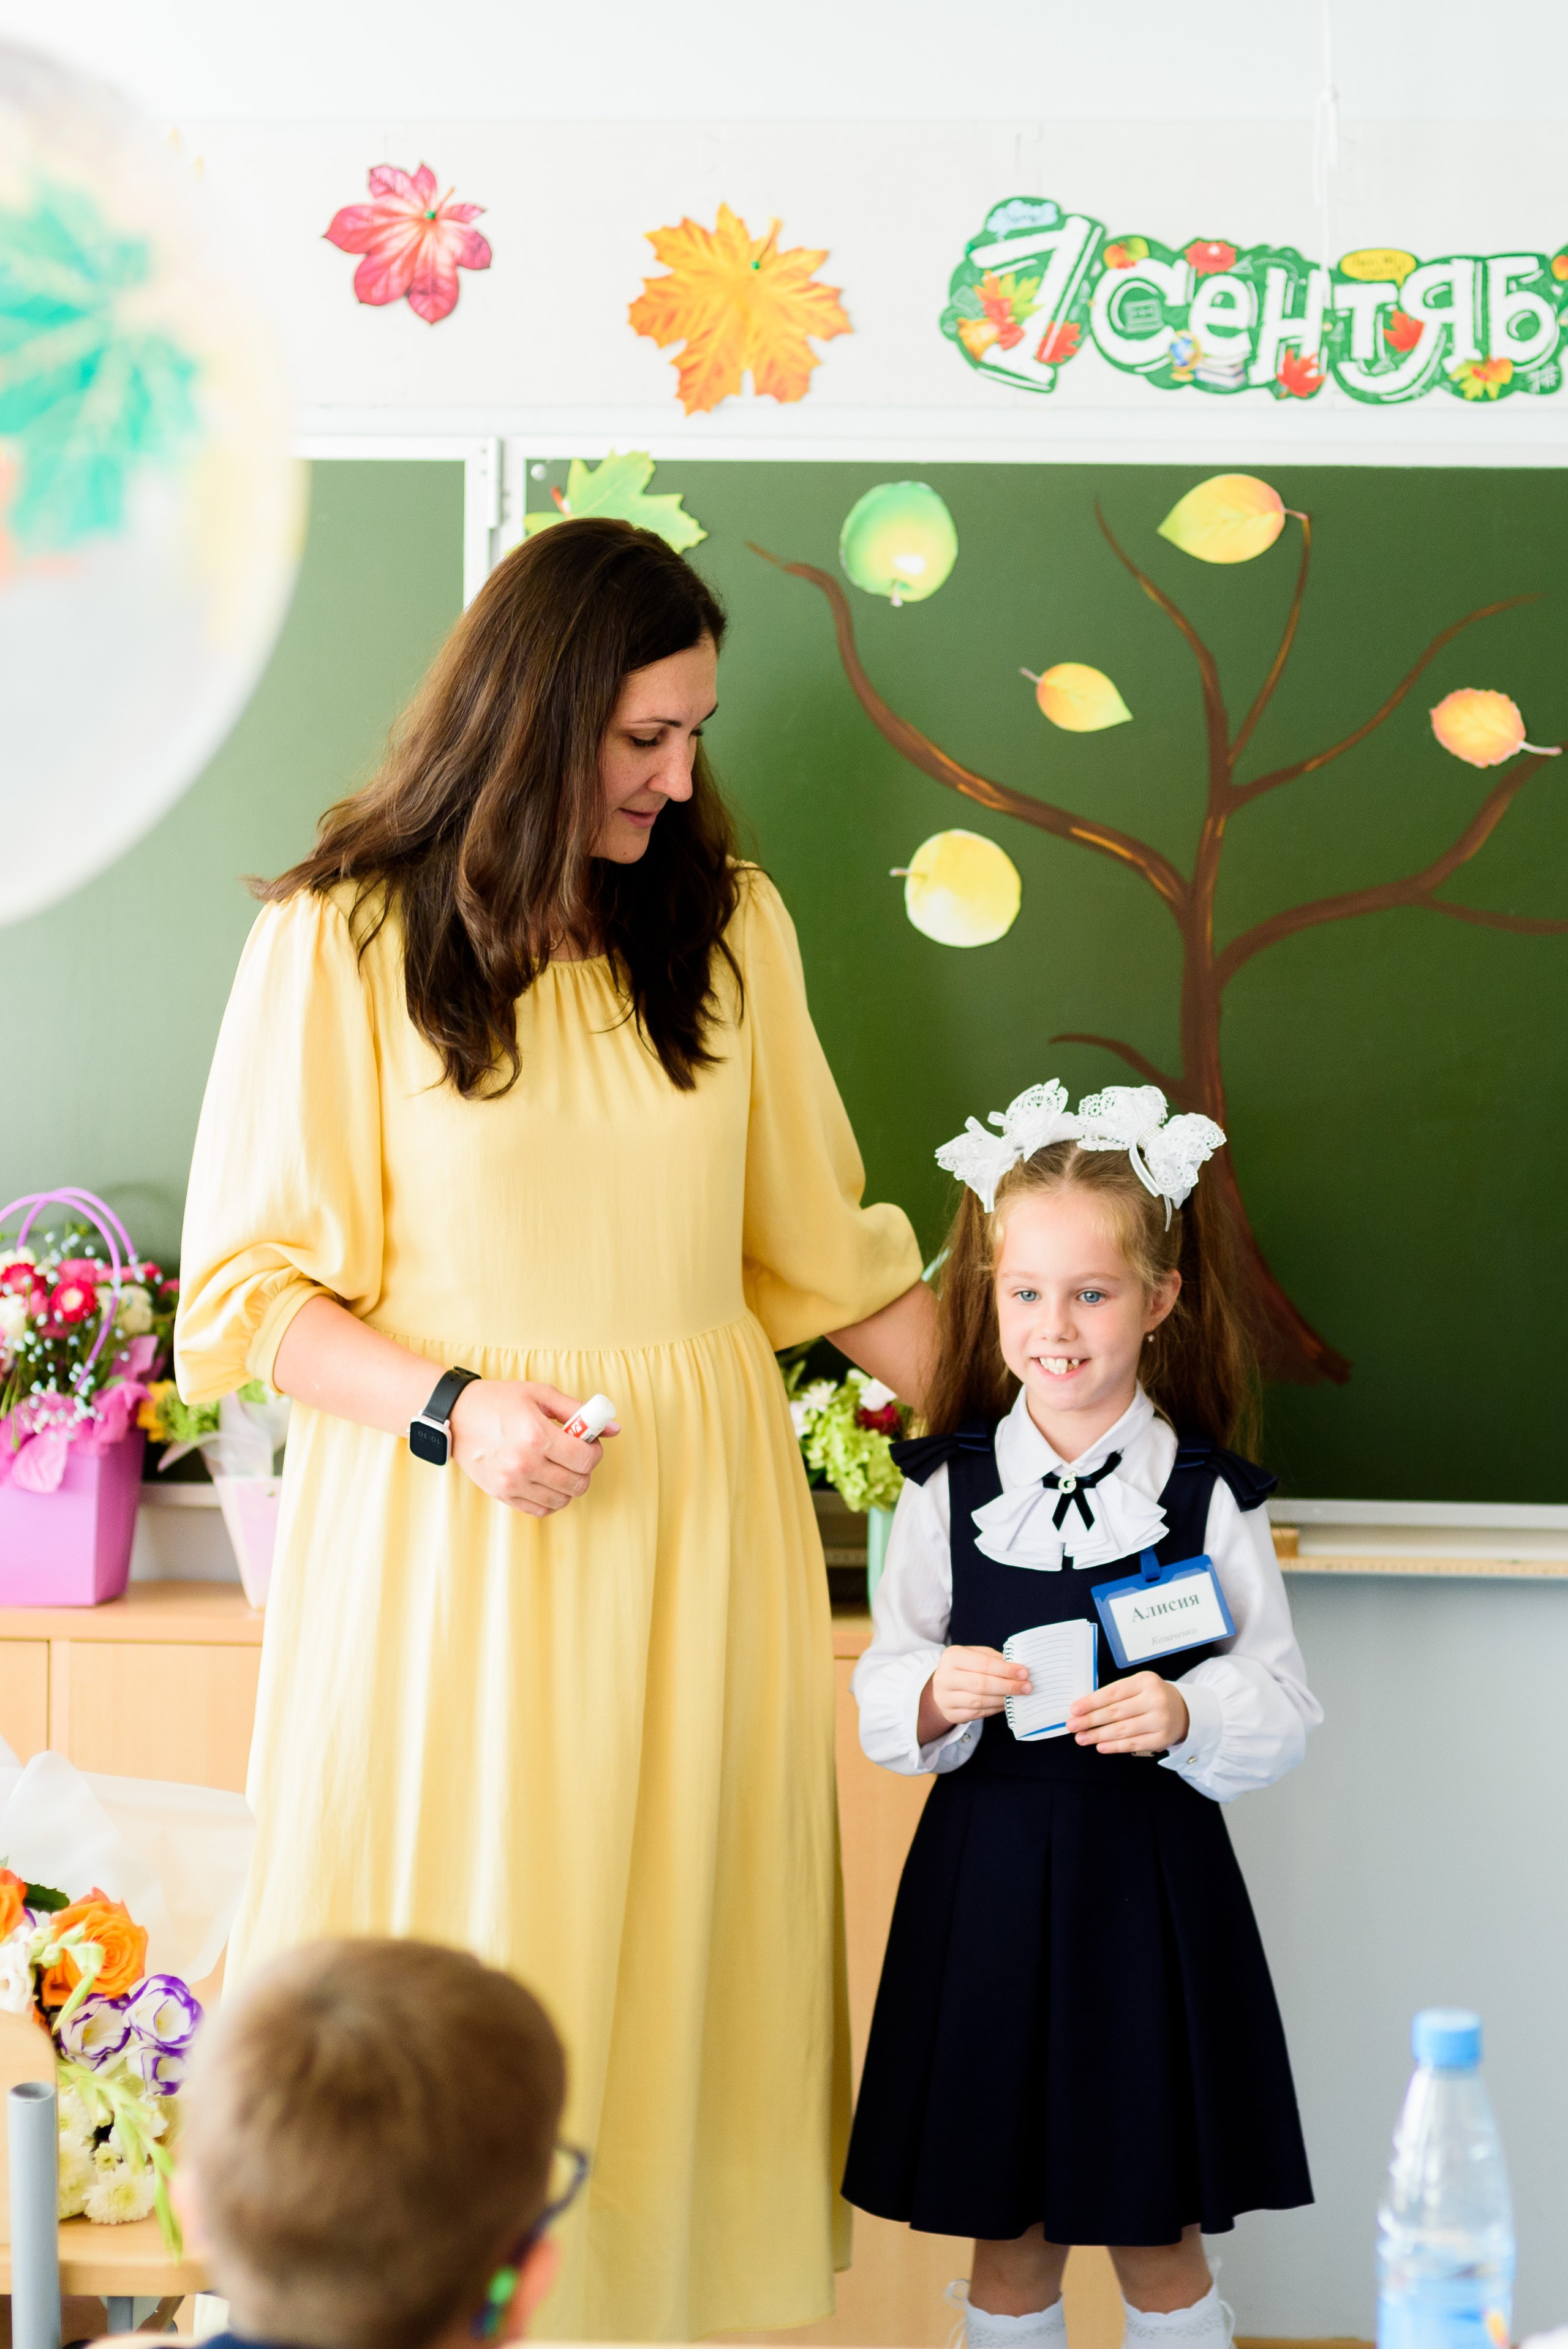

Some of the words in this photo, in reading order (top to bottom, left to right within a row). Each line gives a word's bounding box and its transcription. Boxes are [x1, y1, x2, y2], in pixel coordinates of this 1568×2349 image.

[418, 1430, 440, 1444] 10:30
[1132, 1594, 1200, 1623] Алисия
[1152, 1628, 1197, 1646] Козаченко
